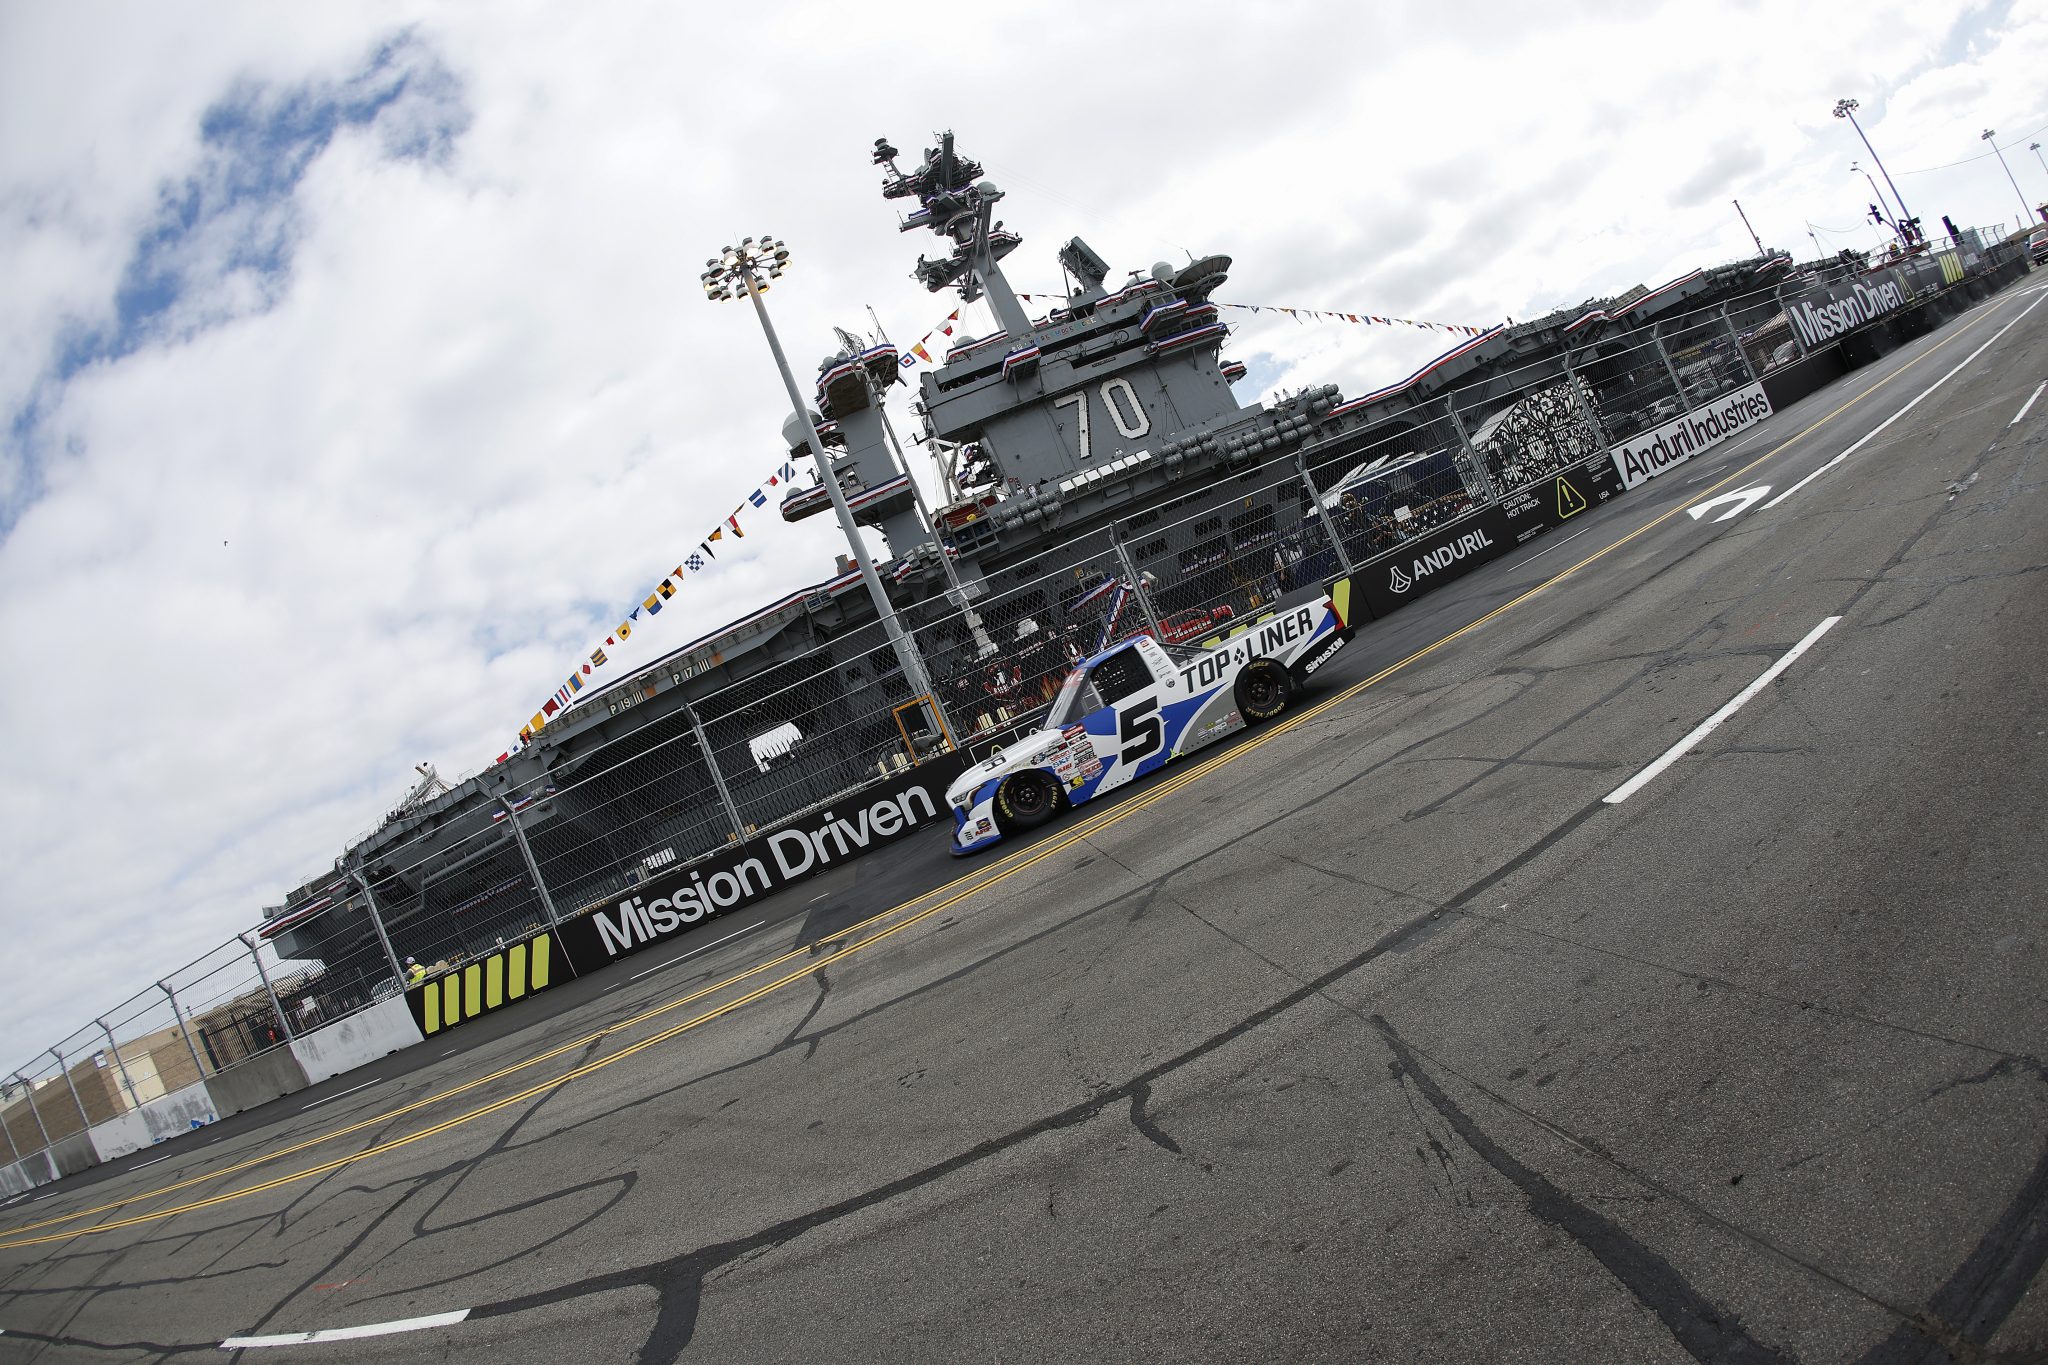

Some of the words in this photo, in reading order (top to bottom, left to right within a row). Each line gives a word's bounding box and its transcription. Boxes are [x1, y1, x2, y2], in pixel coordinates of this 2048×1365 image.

[1790, 294, 1864, 347] Mission
[1852, 280, 1904, 319] Driven
[1053, 377, 1150, 459] 70
[1622, 422, 1695, 482] Anduril
[1687, 392, 1768, 446] Industries
[1503, 493, 1532, 510] CAUTION:
[1507, 507, 1520, 519] HOT
[1521, 498, 1541, 513] TRACK
[1598, 490, 1610, 500] USA
[1413, 528, 1493, 581] ANDURIL
[673, 674, 680, 685] P
[683, 667, 692, 679] 17
[1180, 649, 1231, 694] TOP
[1245, 607, 1313, 662] LINER
[1305, 637, 1345, 674] SiriusXM
[609, 705, 617, 715] P
[620, 697, 631, 710] 19
[1120, 695, 1161, 766] 5
[592, 858, 772, 956] Mission
[767, 785, 937, 880] Driven
